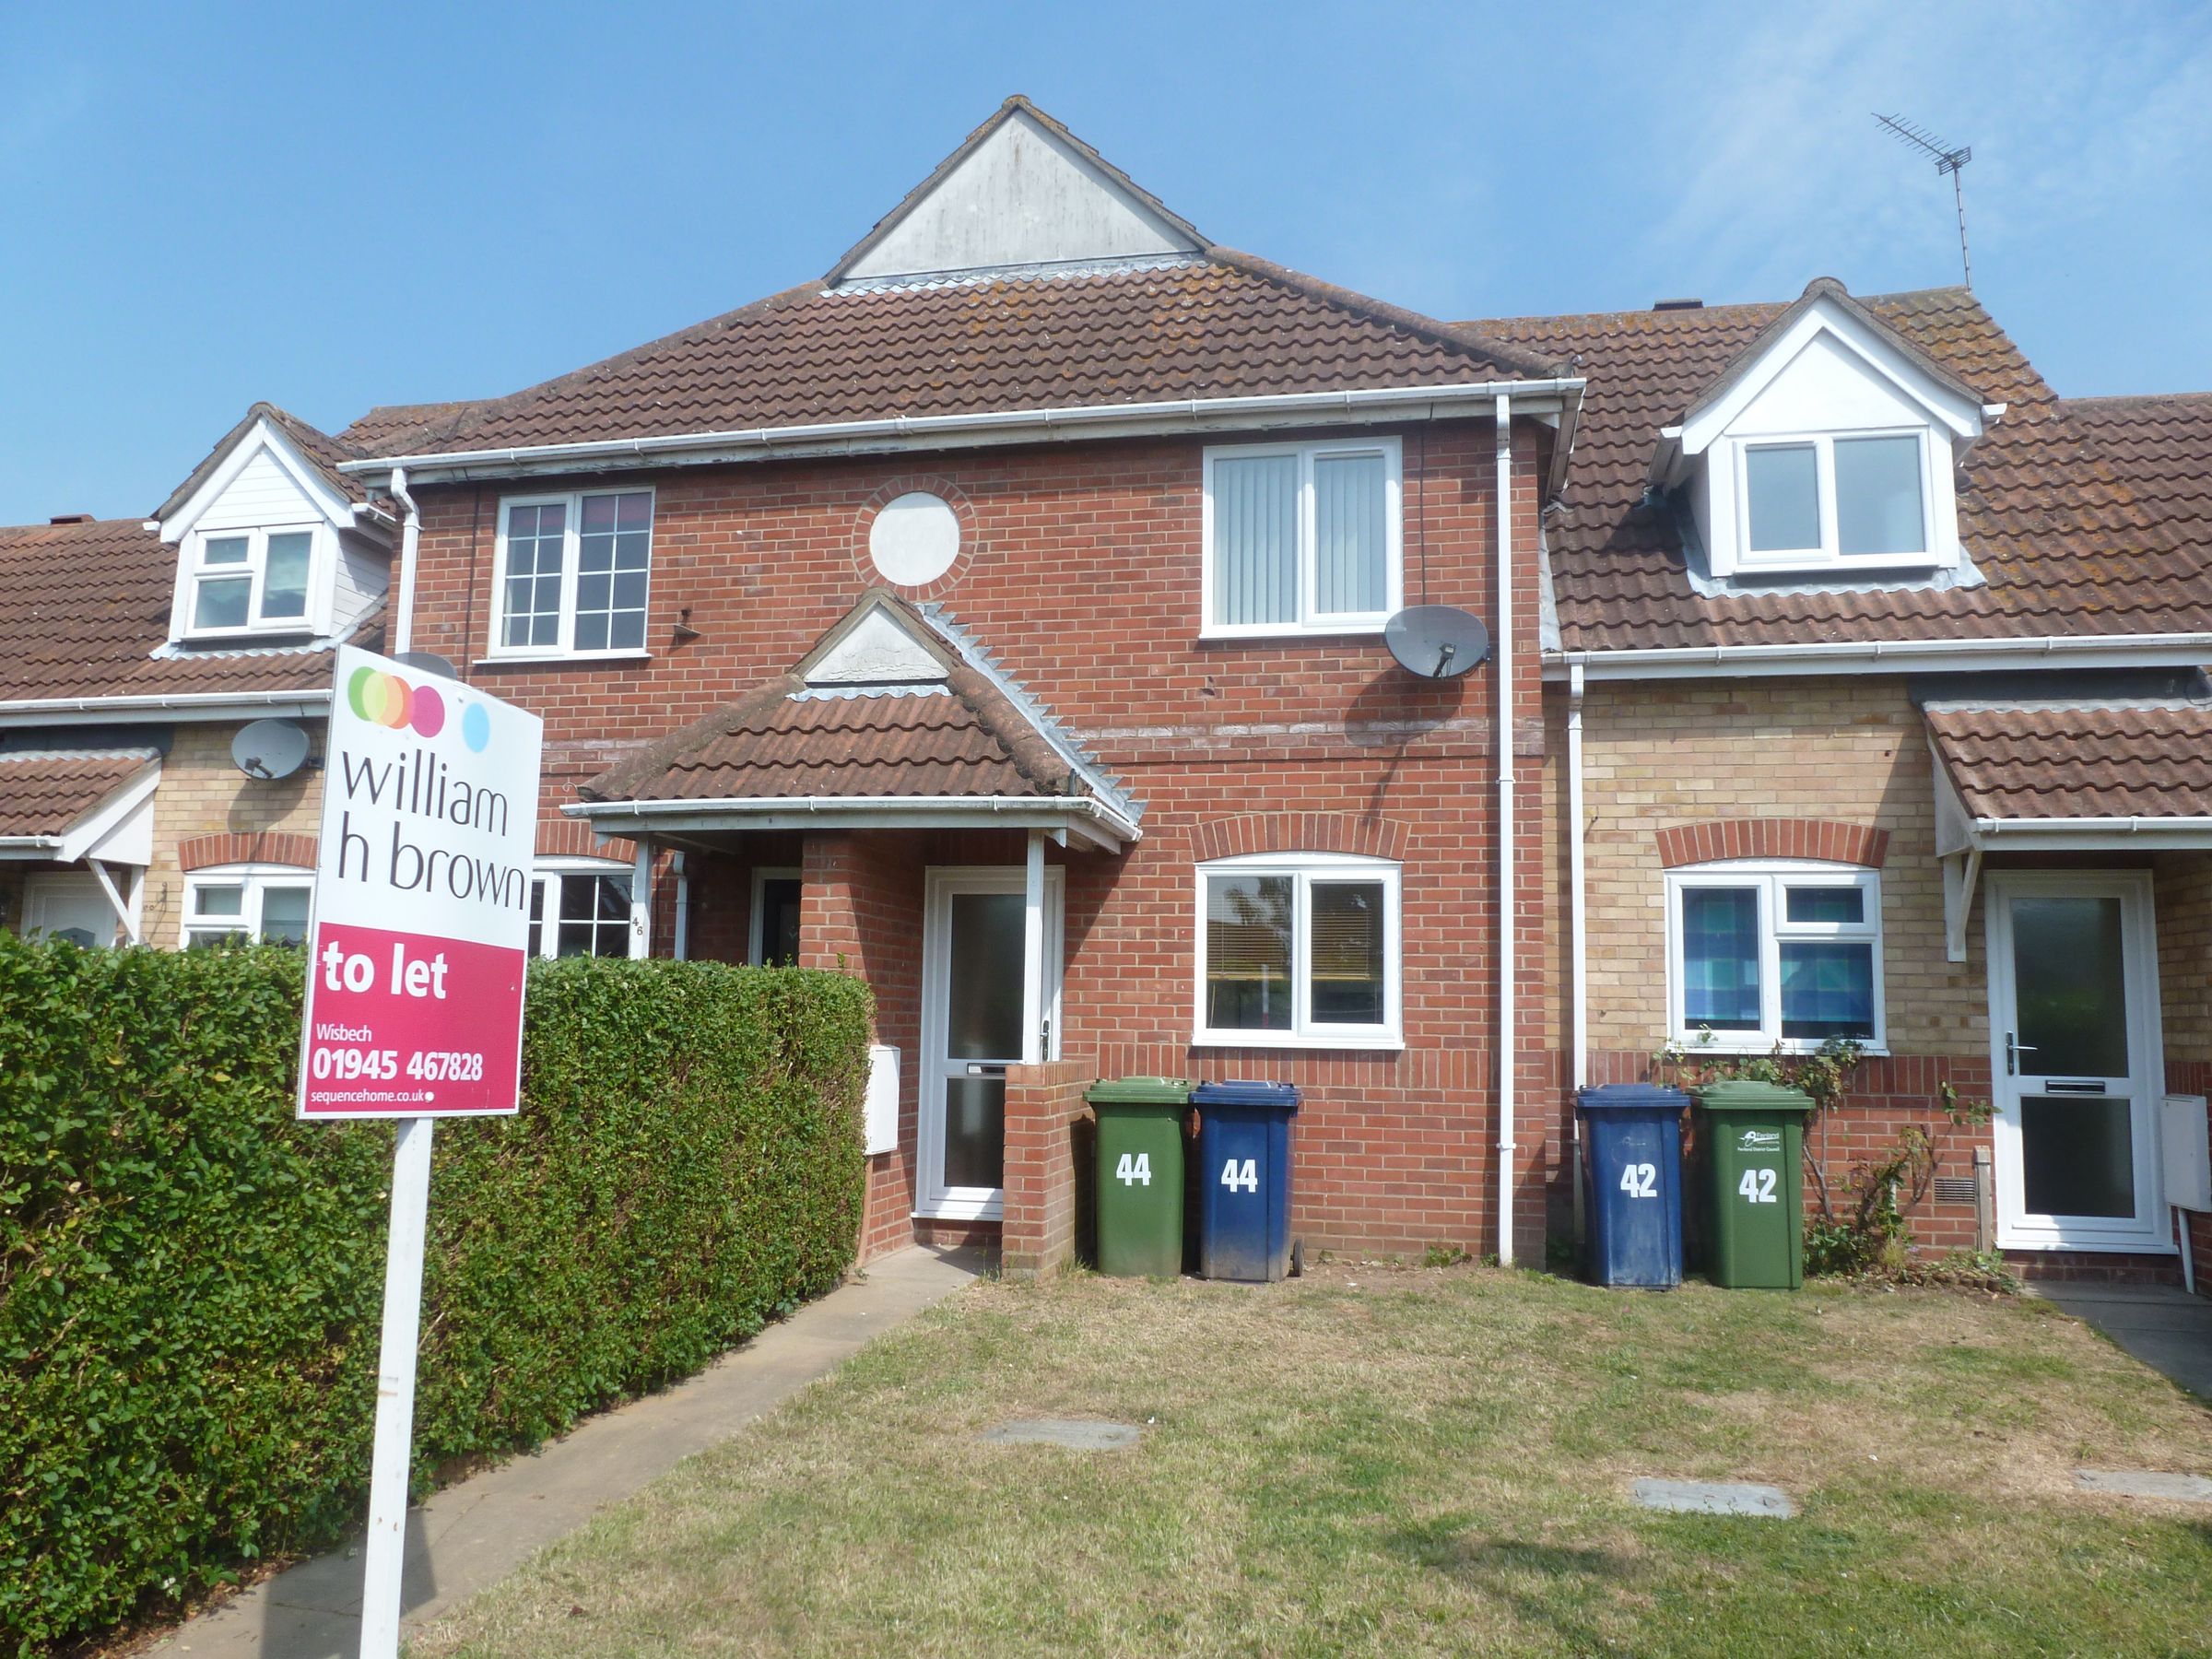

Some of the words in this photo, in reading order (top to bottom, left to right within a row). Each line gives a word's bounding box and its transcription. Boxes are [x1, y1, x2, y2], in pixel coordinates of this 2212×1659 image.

[342, 748, 508, 836] william
[338, 810, 370, 883] h
[389, 821, 525, 910] brown
[323, 940, 374, 993] to
[391, 942, 448, 999] let
[316, 1023, 372, 1041] Wisbech
[312, 1047, 398, 1080] 01945
[406, 1051, 484, 1081] 467828
[311, 1088, 424, 1105] sequencehome.co.uk
[1116, 1153, 1151, 1186] 44
[1221, 1159, 1258, 1193] 44
[1620, 1163, 1657, 1198] 42
[1739, 1169, 1777, 1203] 42
